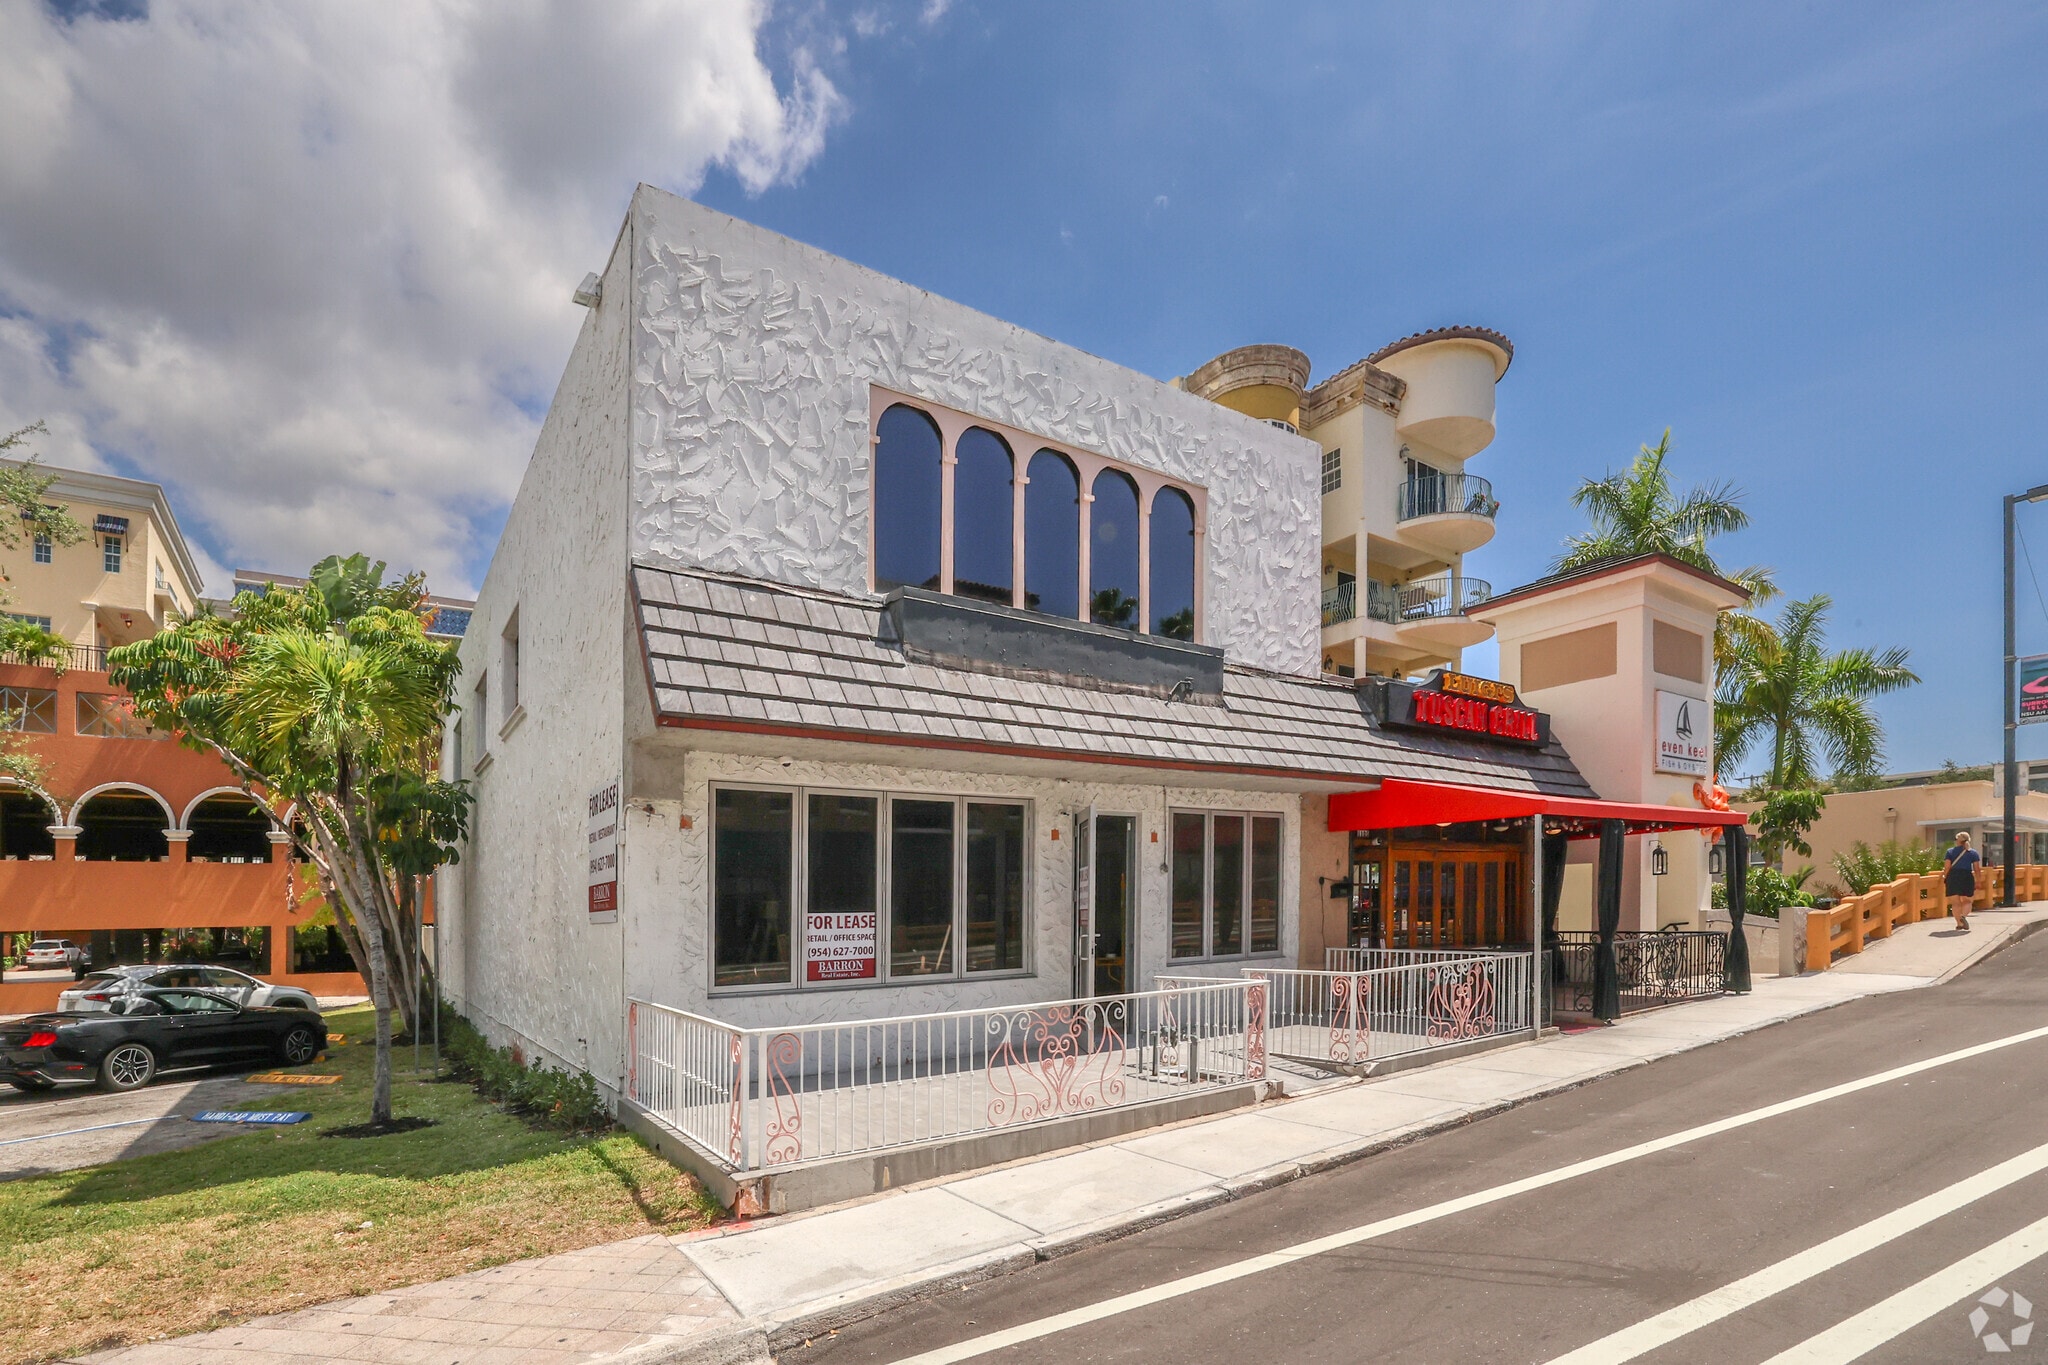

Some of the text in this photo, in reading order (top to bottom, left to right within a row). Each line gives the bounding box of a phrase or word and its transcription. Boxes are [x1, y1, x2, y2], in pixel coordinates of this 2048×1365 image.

[1412, 690, 1539, 741] TUSCAN GRILL
[1661, 741, 1708, 758] even keel
[589, 784, 616, 819] FOR LEASE
[807, 915, 876, 930] FOR LEASE
[833, 933, 856, 942] OFFICE
[857, 933, 876, 941] SPACE
[808, 946, 873, 958] (954) 627-7000
[819, 960, 864, 971] BARRON
[271, 1112, 293, 1121] PAY
